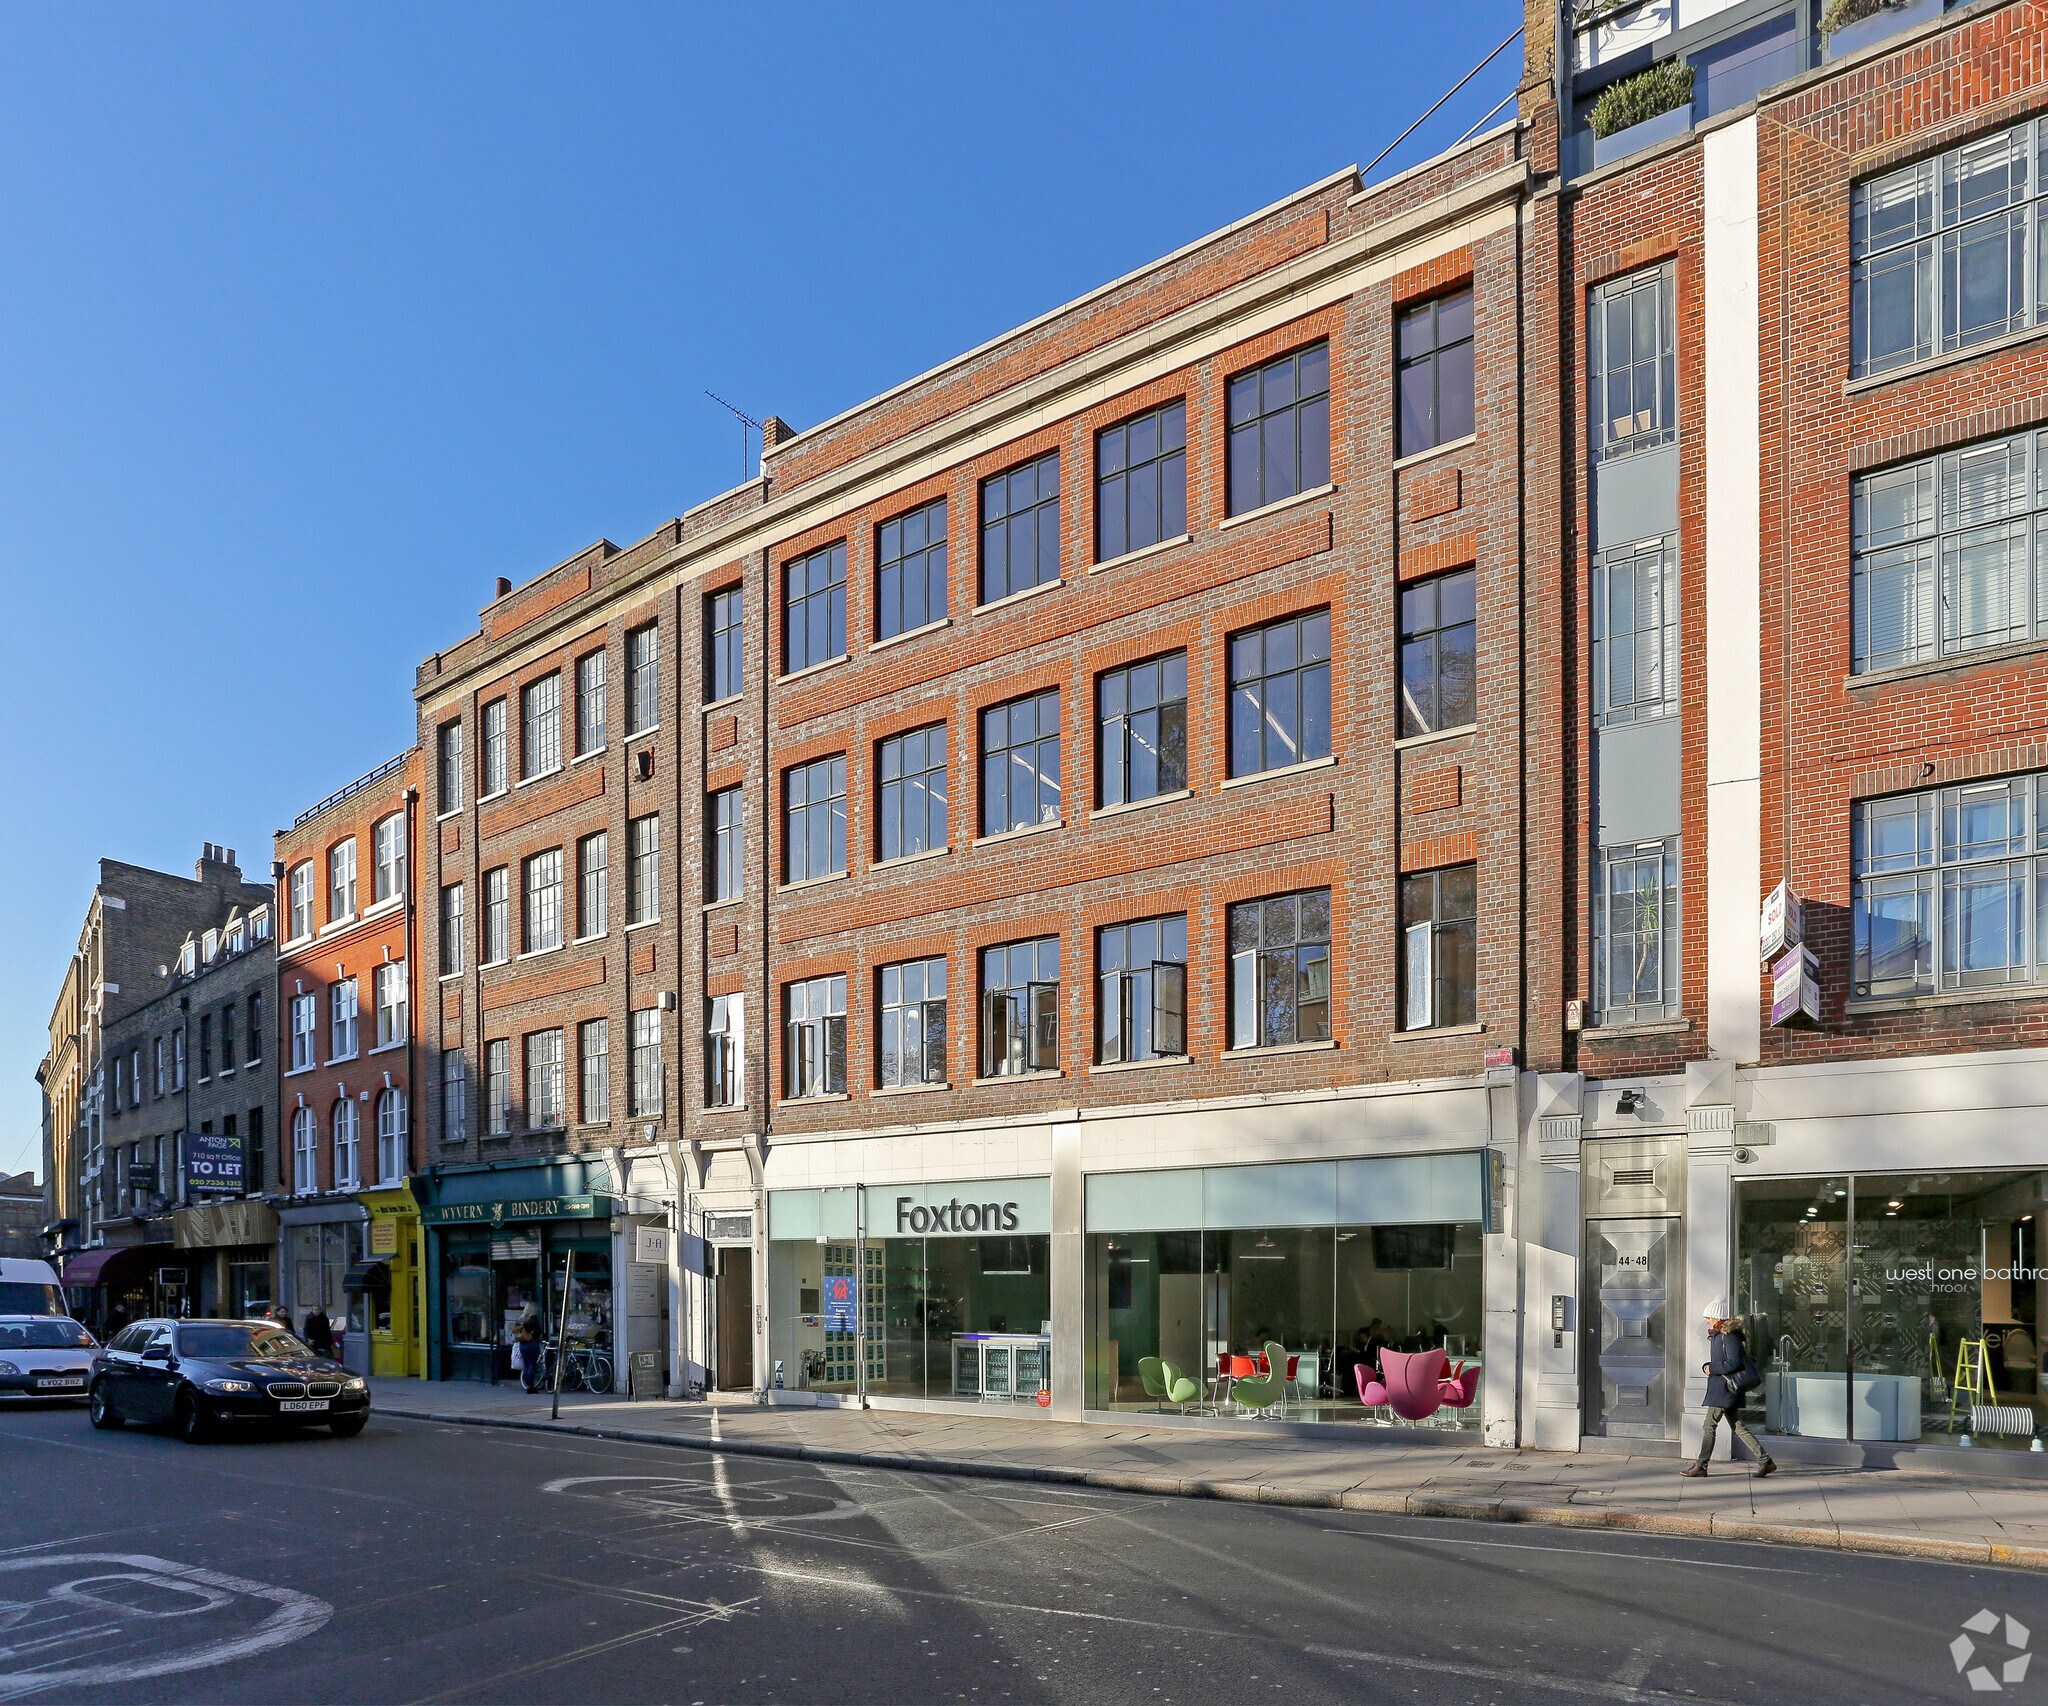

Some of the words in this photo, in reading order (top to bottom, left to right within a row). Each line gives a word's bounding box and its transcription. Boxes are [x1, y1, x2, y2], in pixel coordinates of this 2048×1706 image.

[199, 1136, 227, 1144] ANTON
[191, 1161, 213, 1174] TO
[218, 1163, 242, 1175] LET
[441, 1205, 483, 1220] WYVERN
[511, 1200, 560, 1216] BINDERY
[896, 1196, 1019, 1233] Foxtons
[1618, 1256, 1647, 1265] 44-48
[1886, 1260, 1931, 1281] west
[1938, 1268, 1977, 1281] one
[283, 1402, 307, 1410] LD60
[309, 1401, 326, 1409] EPF
